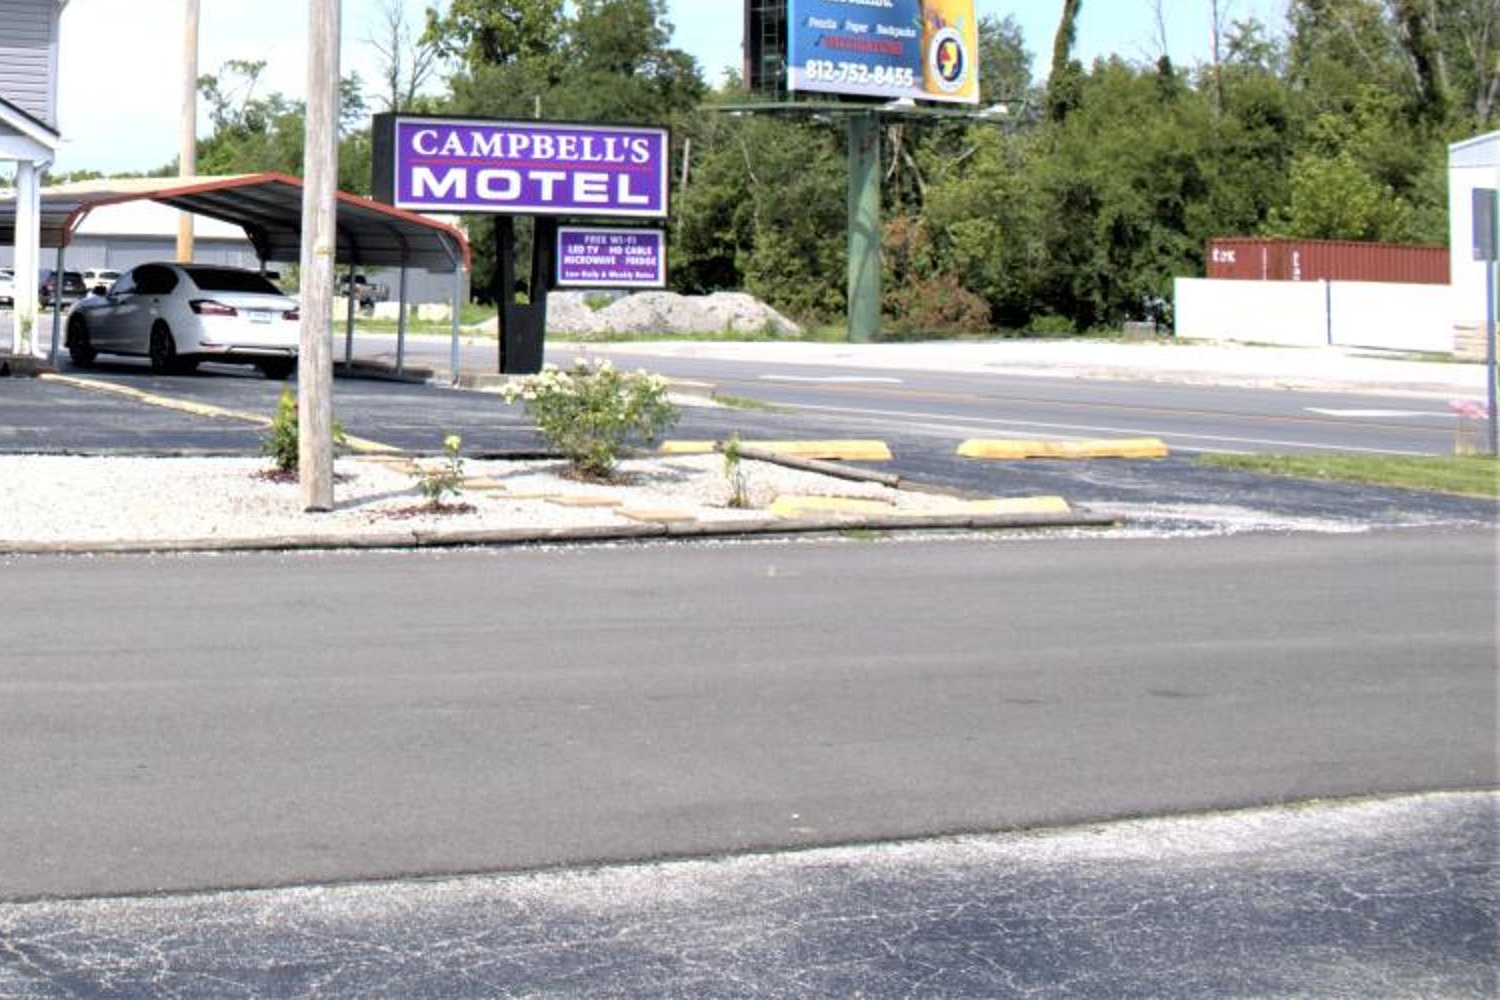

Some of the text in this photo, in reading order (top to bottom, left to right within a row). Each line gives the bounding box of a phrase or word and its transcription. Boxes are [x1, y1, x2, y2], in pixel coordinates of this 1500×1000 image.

[411, 129, 651, 164] CAMPBELL'S
[411, 166, 650, 204] MOTEL
[584, 234, 608, 245] FREE
[567, 244, 585, 255] LED
[586, 245, 599, 254] TV
[625, 246, 653, 256] CABLE
[563, 255, 617, 265] MICROWAVE
